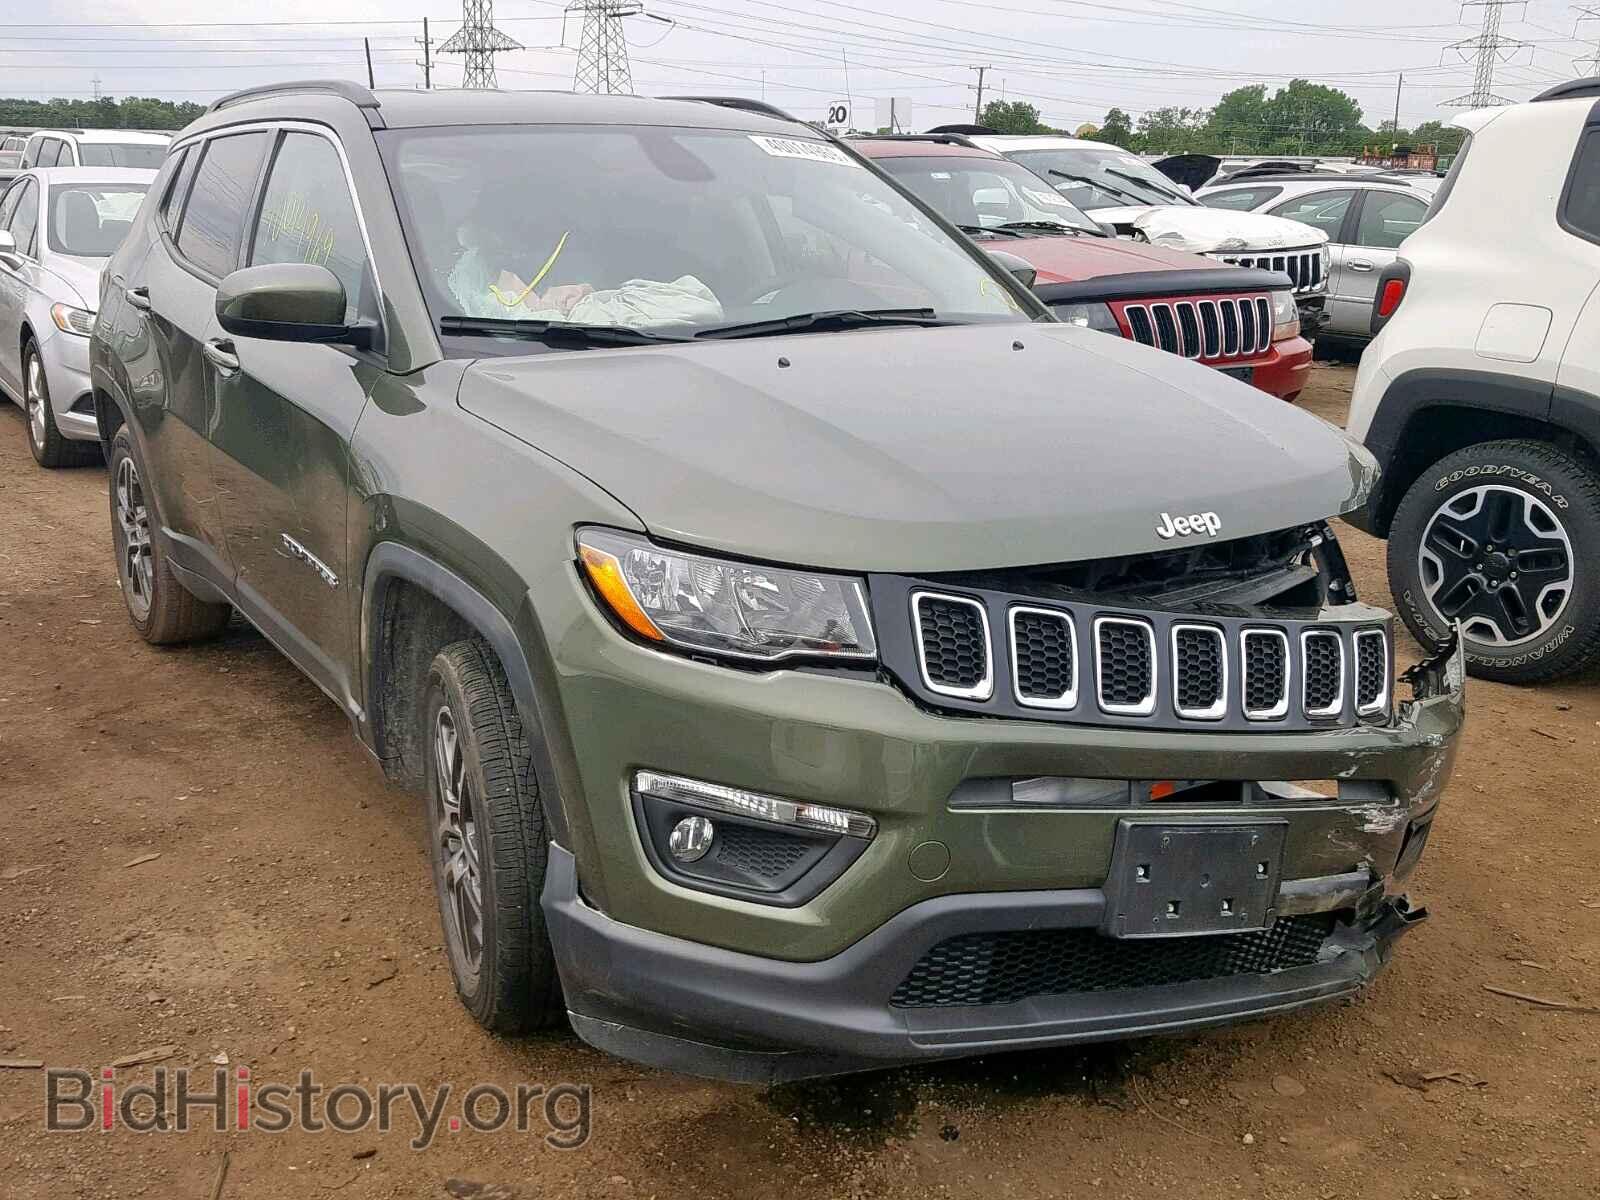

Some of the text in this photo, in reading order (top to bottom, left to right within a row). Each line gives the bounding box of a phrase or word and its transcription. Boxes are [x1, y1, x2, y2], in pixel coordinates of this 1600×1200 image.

[828, 105, 847, 124] 20
[1435, 465, 1568, 508] GOODYEAR
[1156, 511, 1222, 539] Jeep
[1463, 625, 1575, 668] WRANGLE
